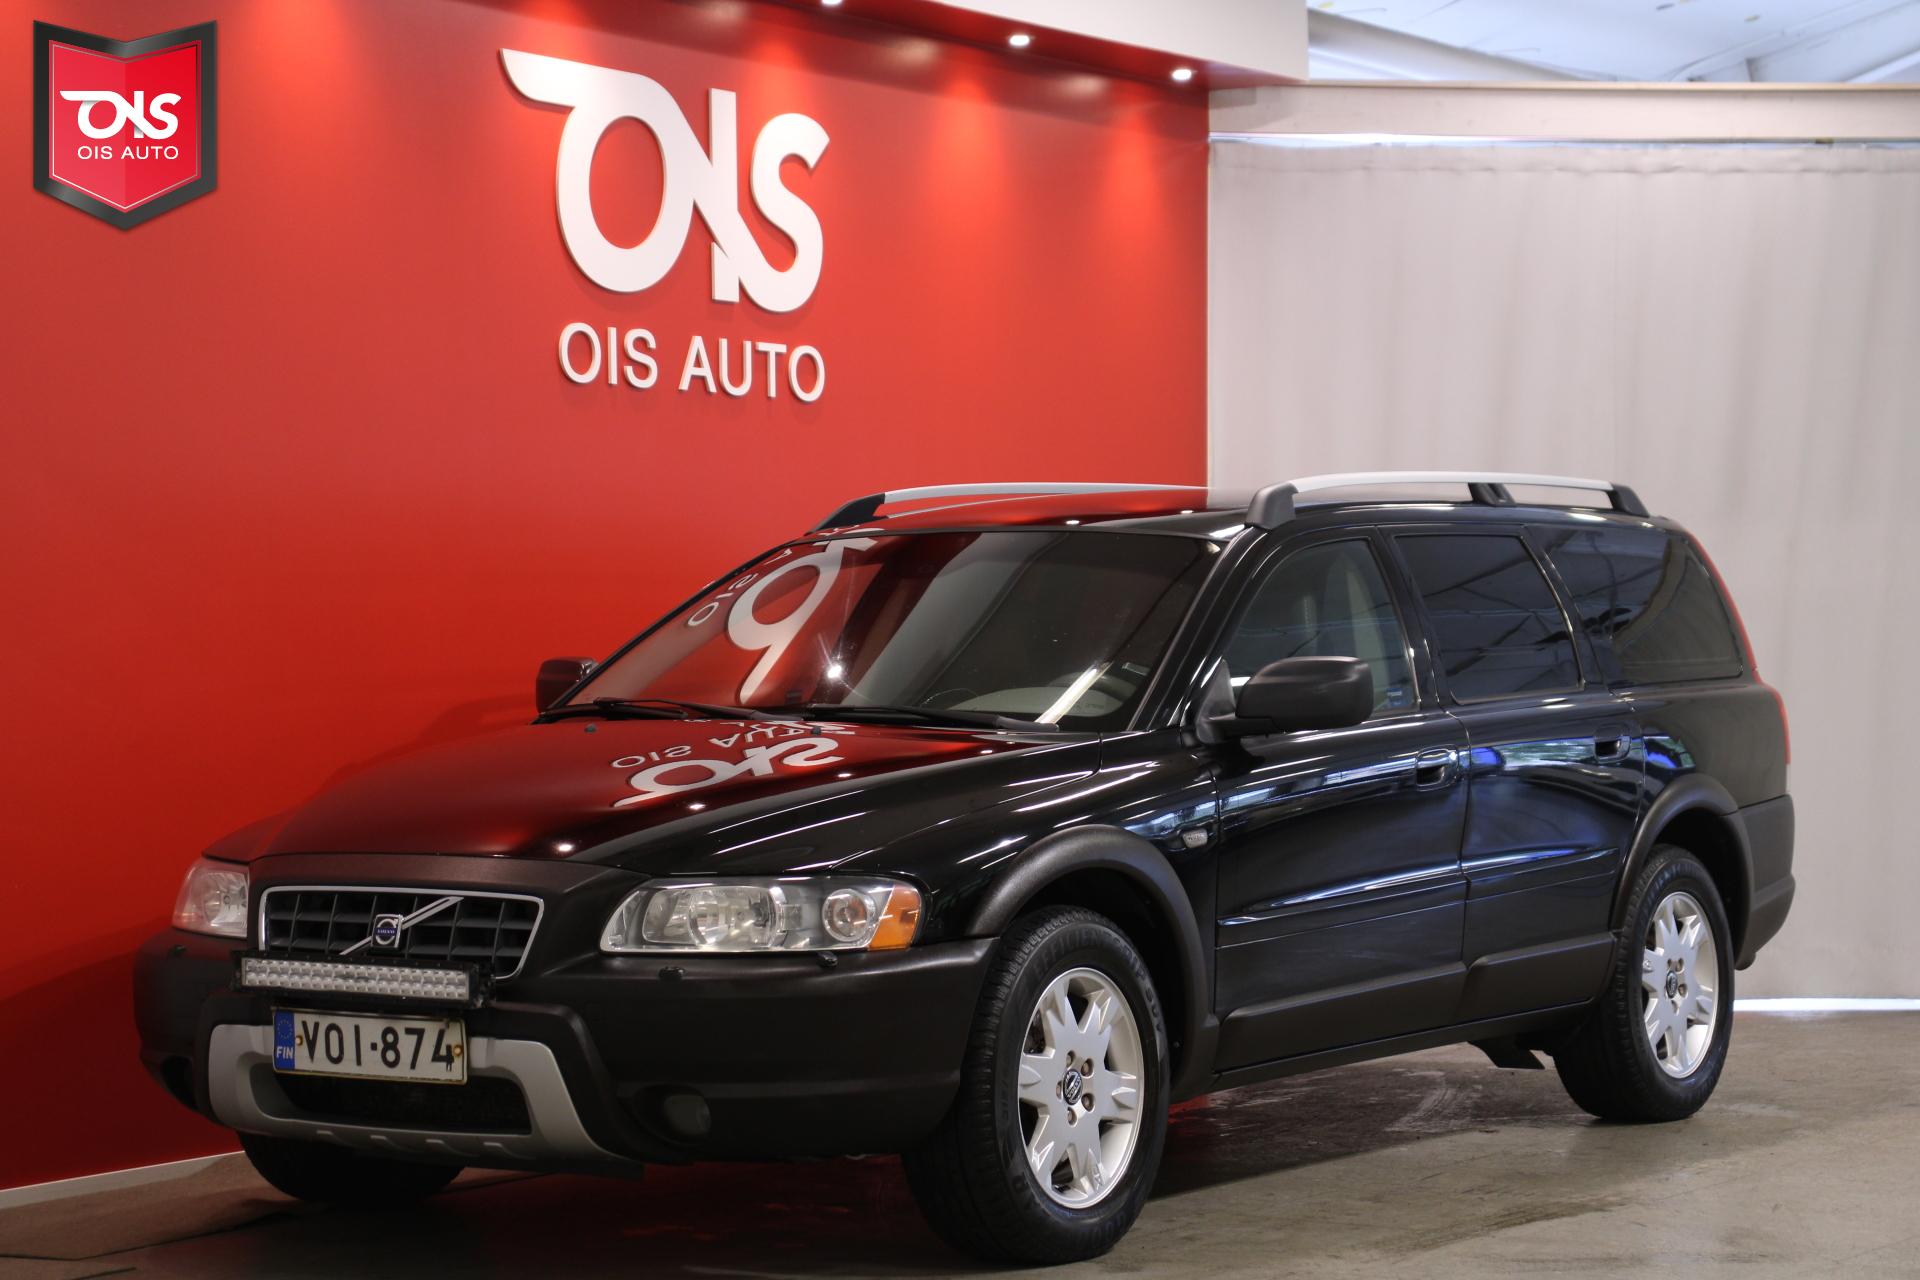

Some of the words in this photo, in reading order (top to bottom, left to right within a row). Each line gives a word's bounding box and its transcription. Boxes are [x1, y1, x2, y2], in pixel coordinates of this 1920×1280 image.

[558, 322, 659, 390] OIS
[677, 335, 826, 403] AUTO
[275, 1045, 294, 1060] FIN
[301, 1020, 456, 1072] VOI-874
